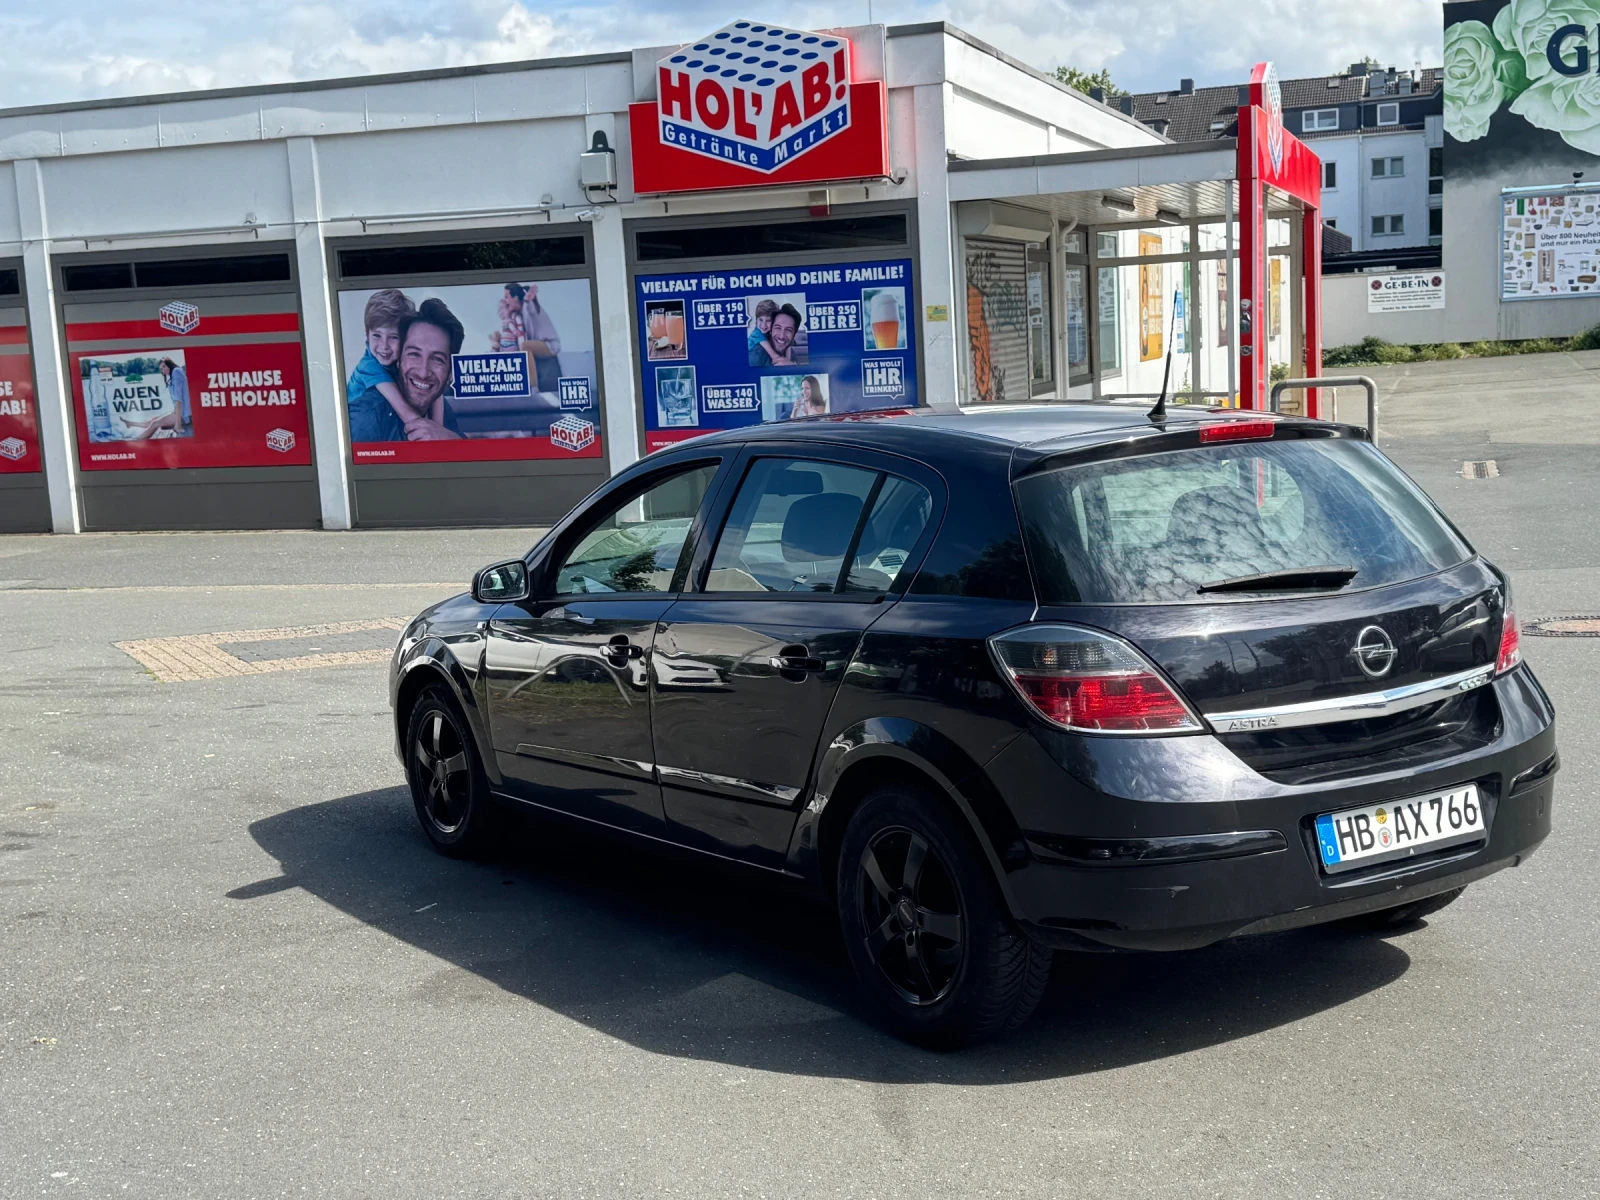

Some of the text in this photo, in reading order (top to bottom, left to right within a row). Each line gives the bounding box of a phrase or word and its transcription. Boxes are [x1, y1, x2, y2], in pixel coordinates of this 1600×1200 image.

[1546, 23, 1600, 78] G
[659, 47, 846, 142] HOL'AB!
[665, 110, 844, 165] Getränke Markt
[1541, 232, 1558, 240] Über
[641, 265, 904, 294] VIELFALT FÜR DICH UND DEINE FAMILIE!
[697, 302, 744, 313] ÜBER 150
[809, 305, 857, 316] ÜBER 250
[698, 313, 745, 326] SÄFTE
[810, 315, 858, 330] BIERE
[458, 358, 522, 374] VIELFALT
[207, 370, 283, 389] ZUHAUSE
[460, 373, 523, 384] FÜR MICH UND
[866, 367, 901, 386] IHR
[113, 386, 160, 400] AUEN
[461, 383, 524, 393] MEINE FAMILIE!
[561, 386, 588, 400] IHR
[706, 387, 753, 398] ÜBER 140
[865, 385, 902, 394] TRINKEN?
[200, 388, 296, 407] BEI HOL'AB!
[707, 398, 753, 409] WASSER
[112, 399, 163, 413] WALD
[1229, 715, 1279, 730] ASTRA
[1335, 813, 1375, 856] HB
[1327, 845, 1334, 857] D
